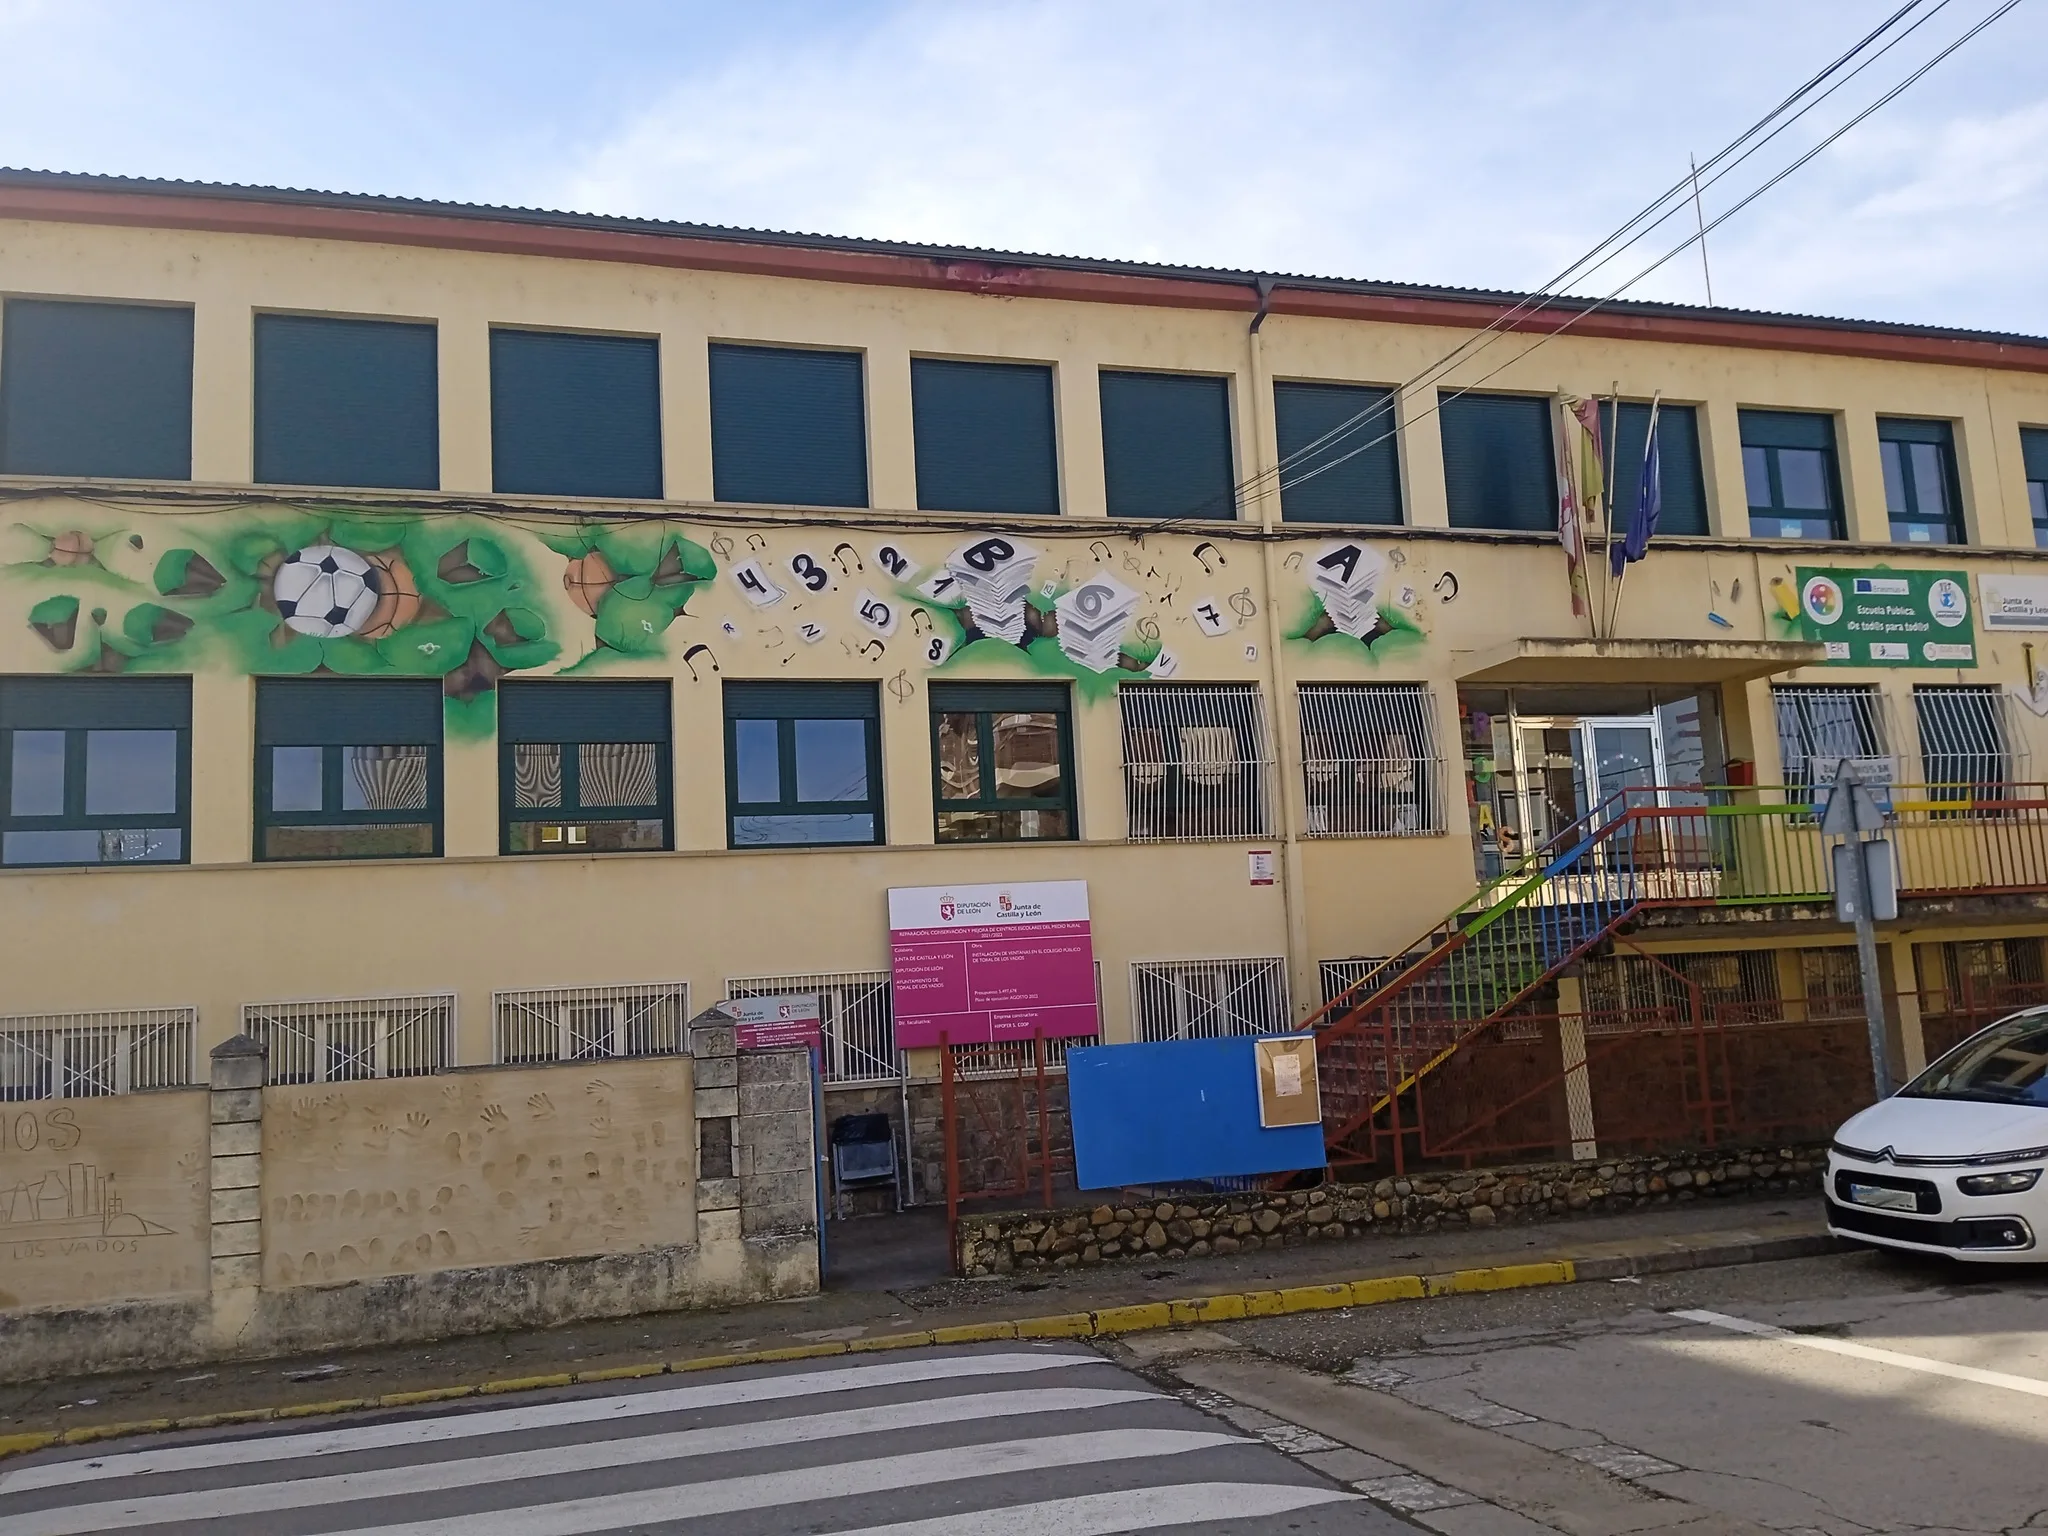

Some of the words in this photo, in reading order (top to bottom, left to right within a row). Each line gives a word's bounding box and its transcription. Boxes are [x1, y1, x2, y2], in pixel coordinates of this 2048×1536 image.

[878, 546, 907, 575] 2
[963, 537, 1014, 571] B
[1316, 543, 1362, 584] A
[736, 567, 767, 595] 4
[791, 553, 829, 592] 3
[932, 576, 955, 598] 1
[859, 599, 890, 627] 5
[1074, 584, 1115, 618] 6
[1857, 605, 1885, 615] Escuela
[723, 622, 735, 634] R
[1197, 604, 1220, 627] 7
[1885, 624, 1904, 634] para
[1159, 653, 1171, 667] V
[13, 1243, 46, 1260] LOS
[60, 1239, 139, 1257] VADOS
